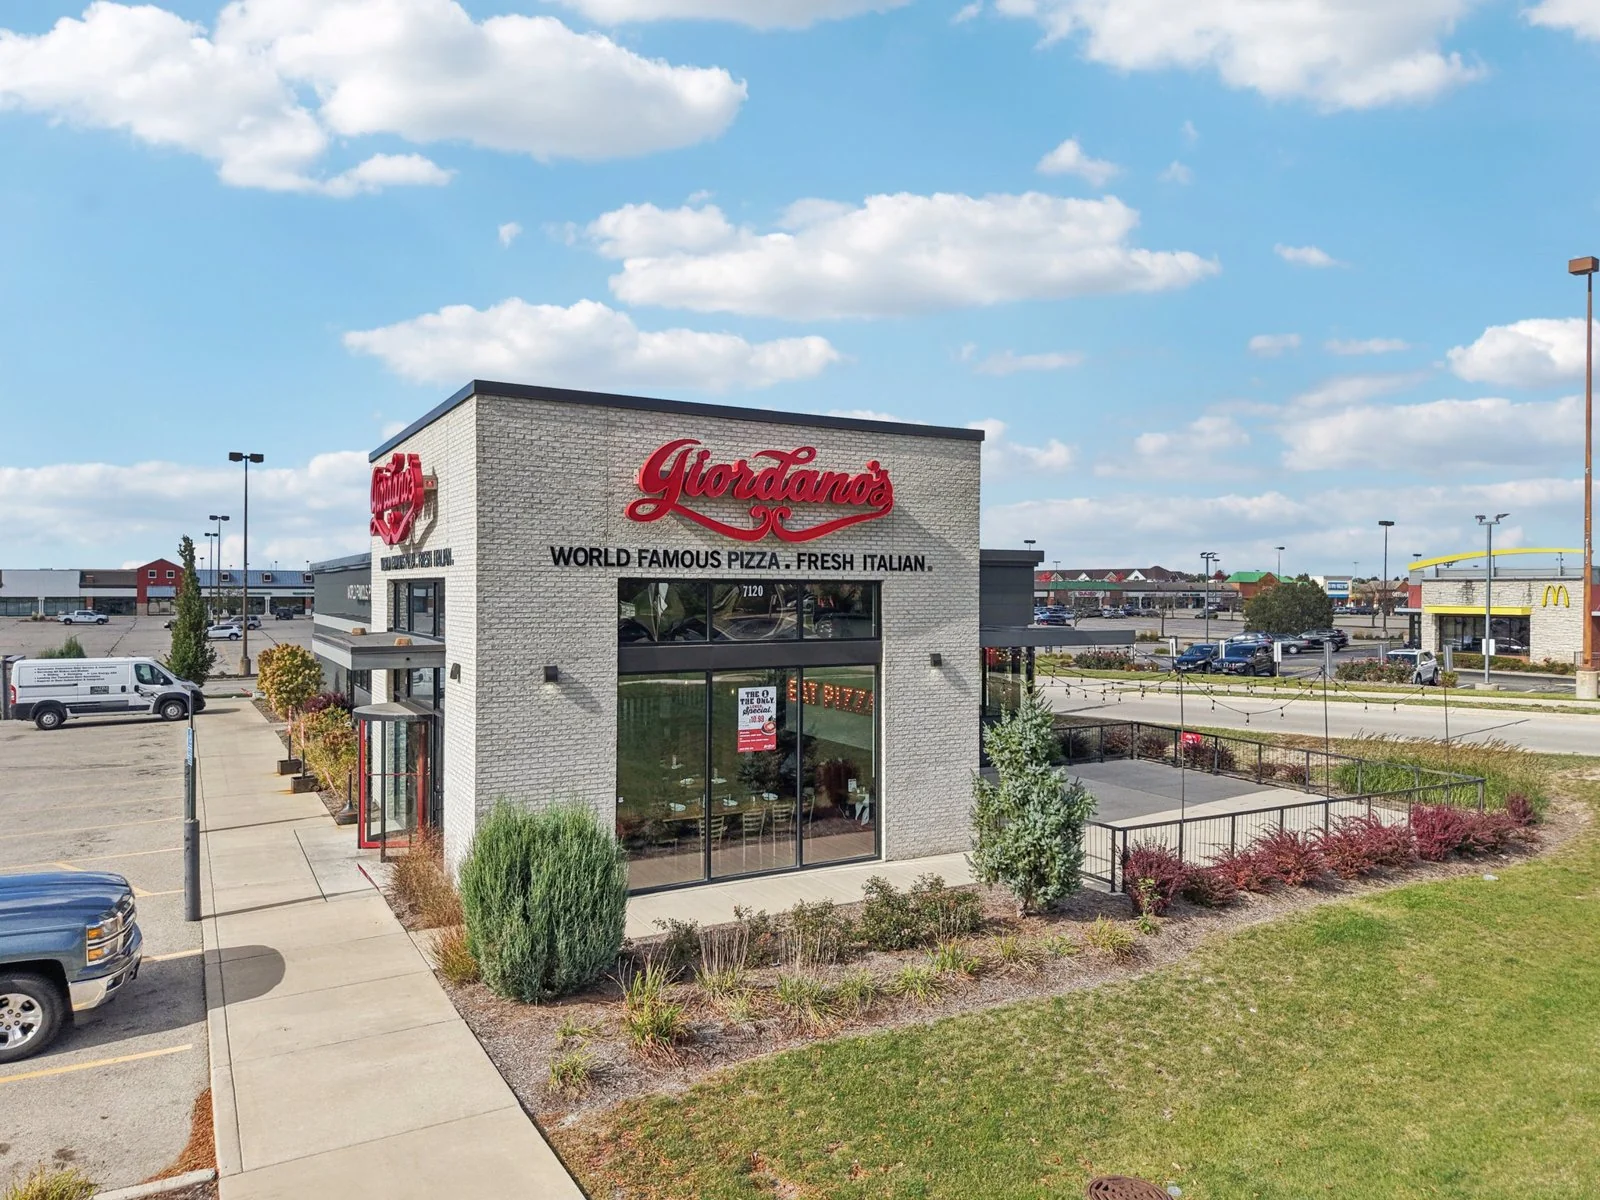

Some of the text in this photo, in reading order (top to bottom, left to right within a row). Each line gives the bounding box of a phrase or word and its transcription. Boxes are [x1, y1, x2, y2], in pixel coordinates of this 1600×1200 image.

[625, 438, 894, 542] Giordano's
[550, 546, 631, 567] WORLD
[637, 549, 722, 569] FAMOUS
[797, 552, 854, 571] FRESH
[743, 585, 764, 597] 7120
